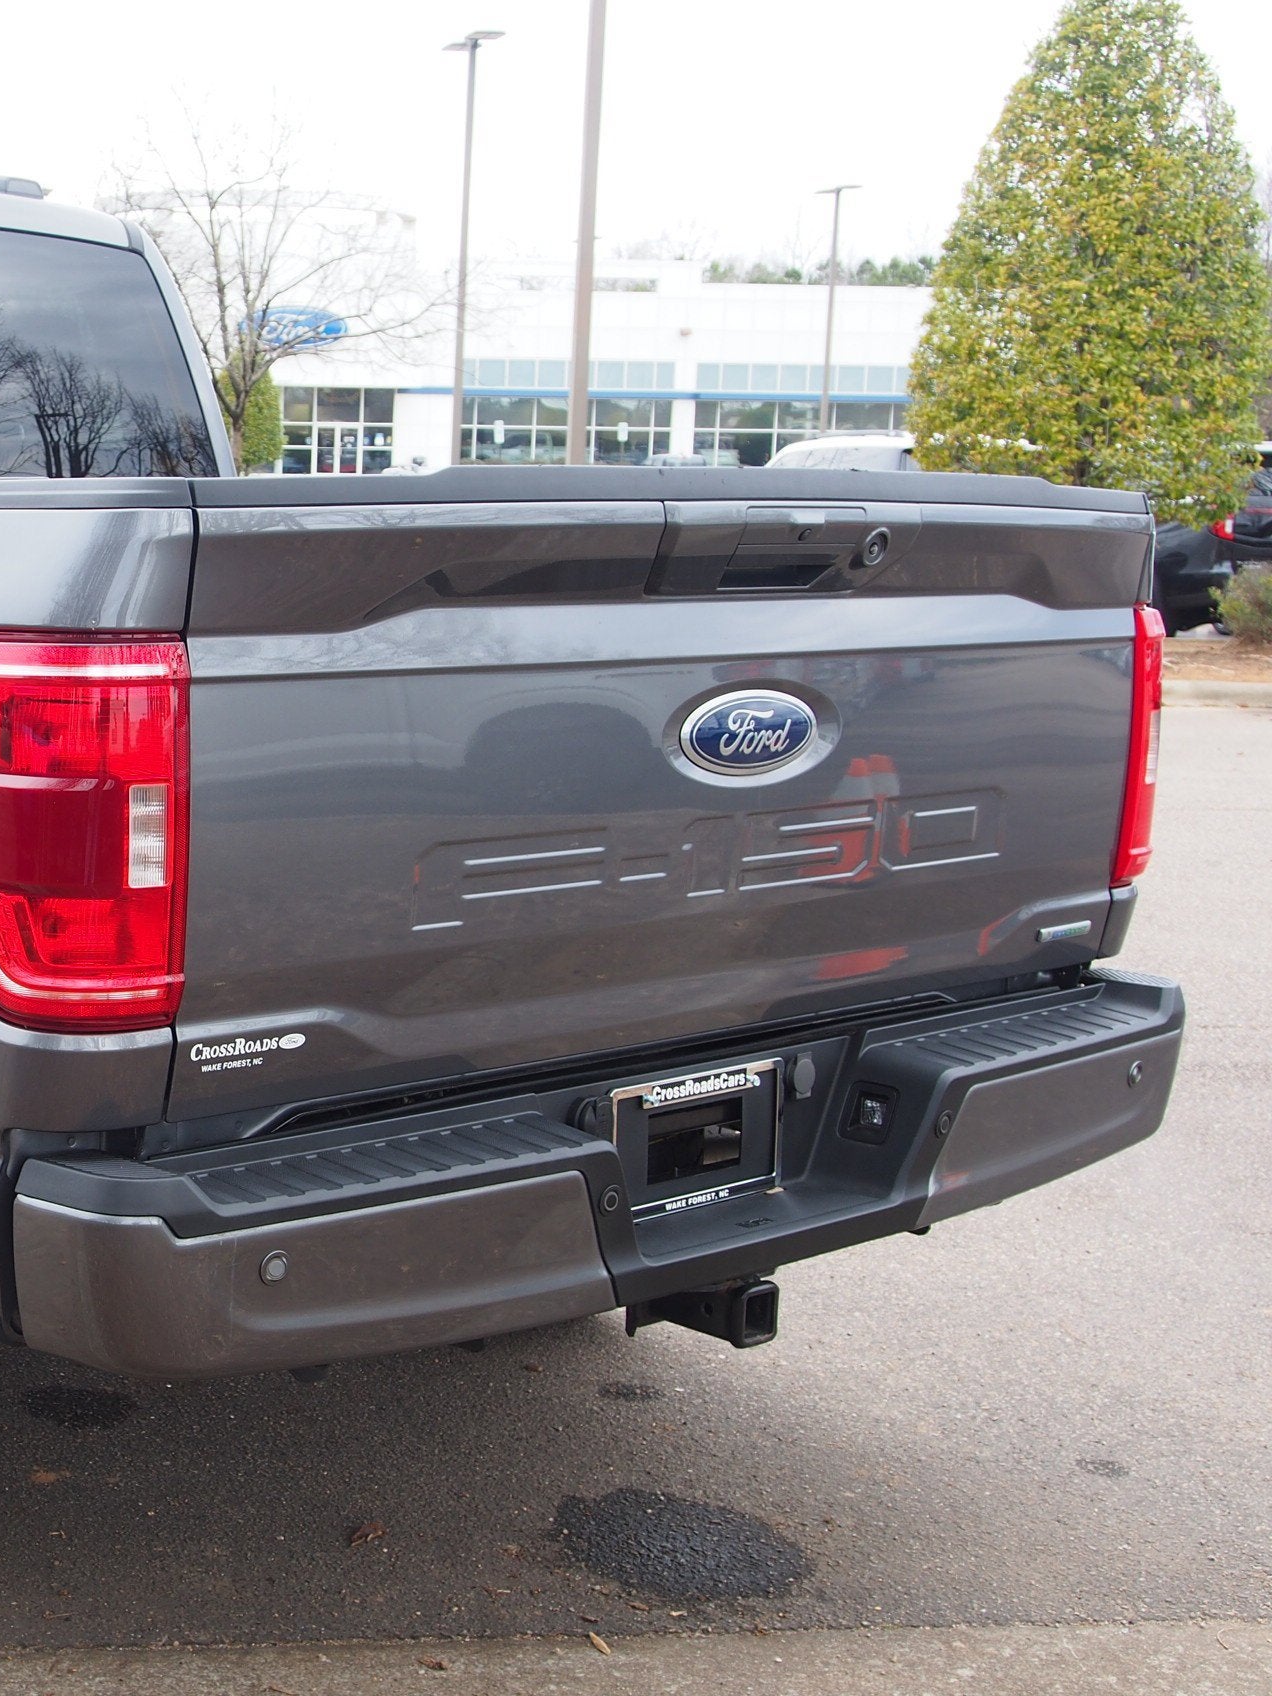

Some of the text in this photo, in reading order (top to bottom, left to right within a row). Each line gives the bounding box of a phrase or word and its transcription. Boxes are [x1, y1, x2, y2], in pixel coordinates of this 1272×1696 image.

[719, 708, 792, 757] Ford
[411, 786, 1007, 932] F-150
[201, 1057, 264, 1073] WAKE FOREST, NC
[652, 1072, 746, 1101] CrossRoadsCars
[665, 1189, 730, 1211] WAKE FOREST, NC
